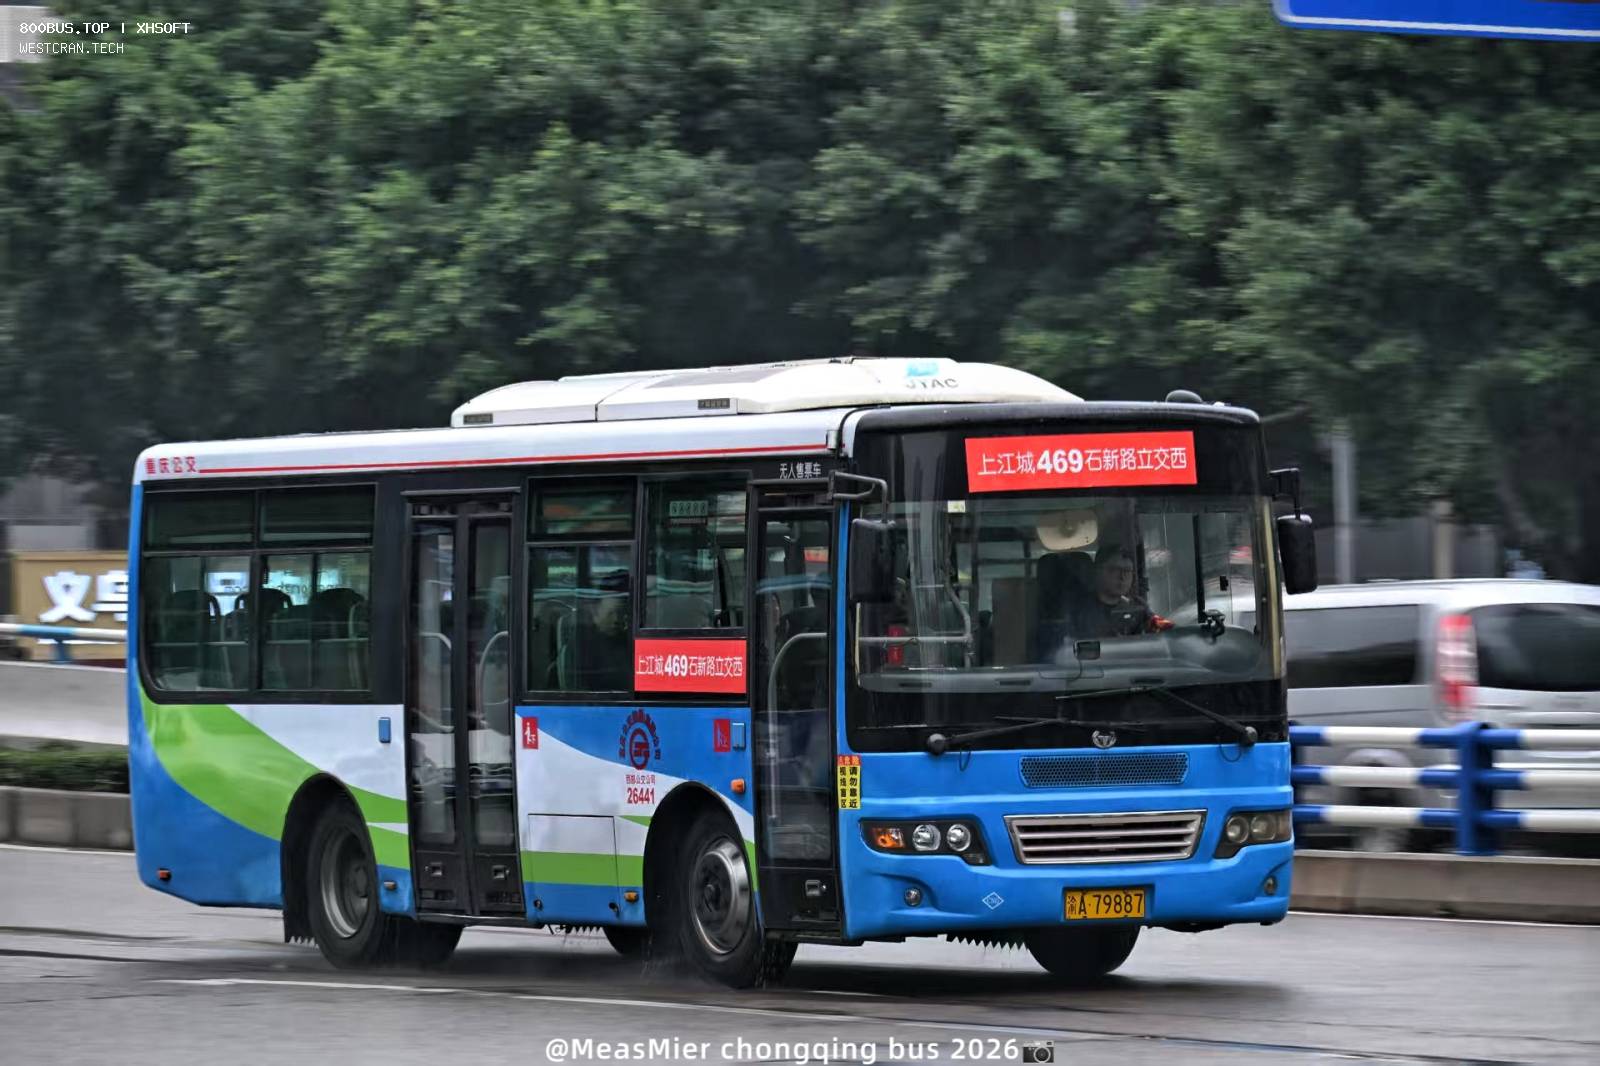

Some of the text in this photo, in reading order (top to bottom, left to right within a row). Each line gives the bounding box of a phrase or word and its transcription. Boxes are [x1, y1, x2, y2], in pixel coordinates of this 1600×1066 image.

[780, 462, 821, 479] 无人售票车
[627, 787, 655, 804] 26441
